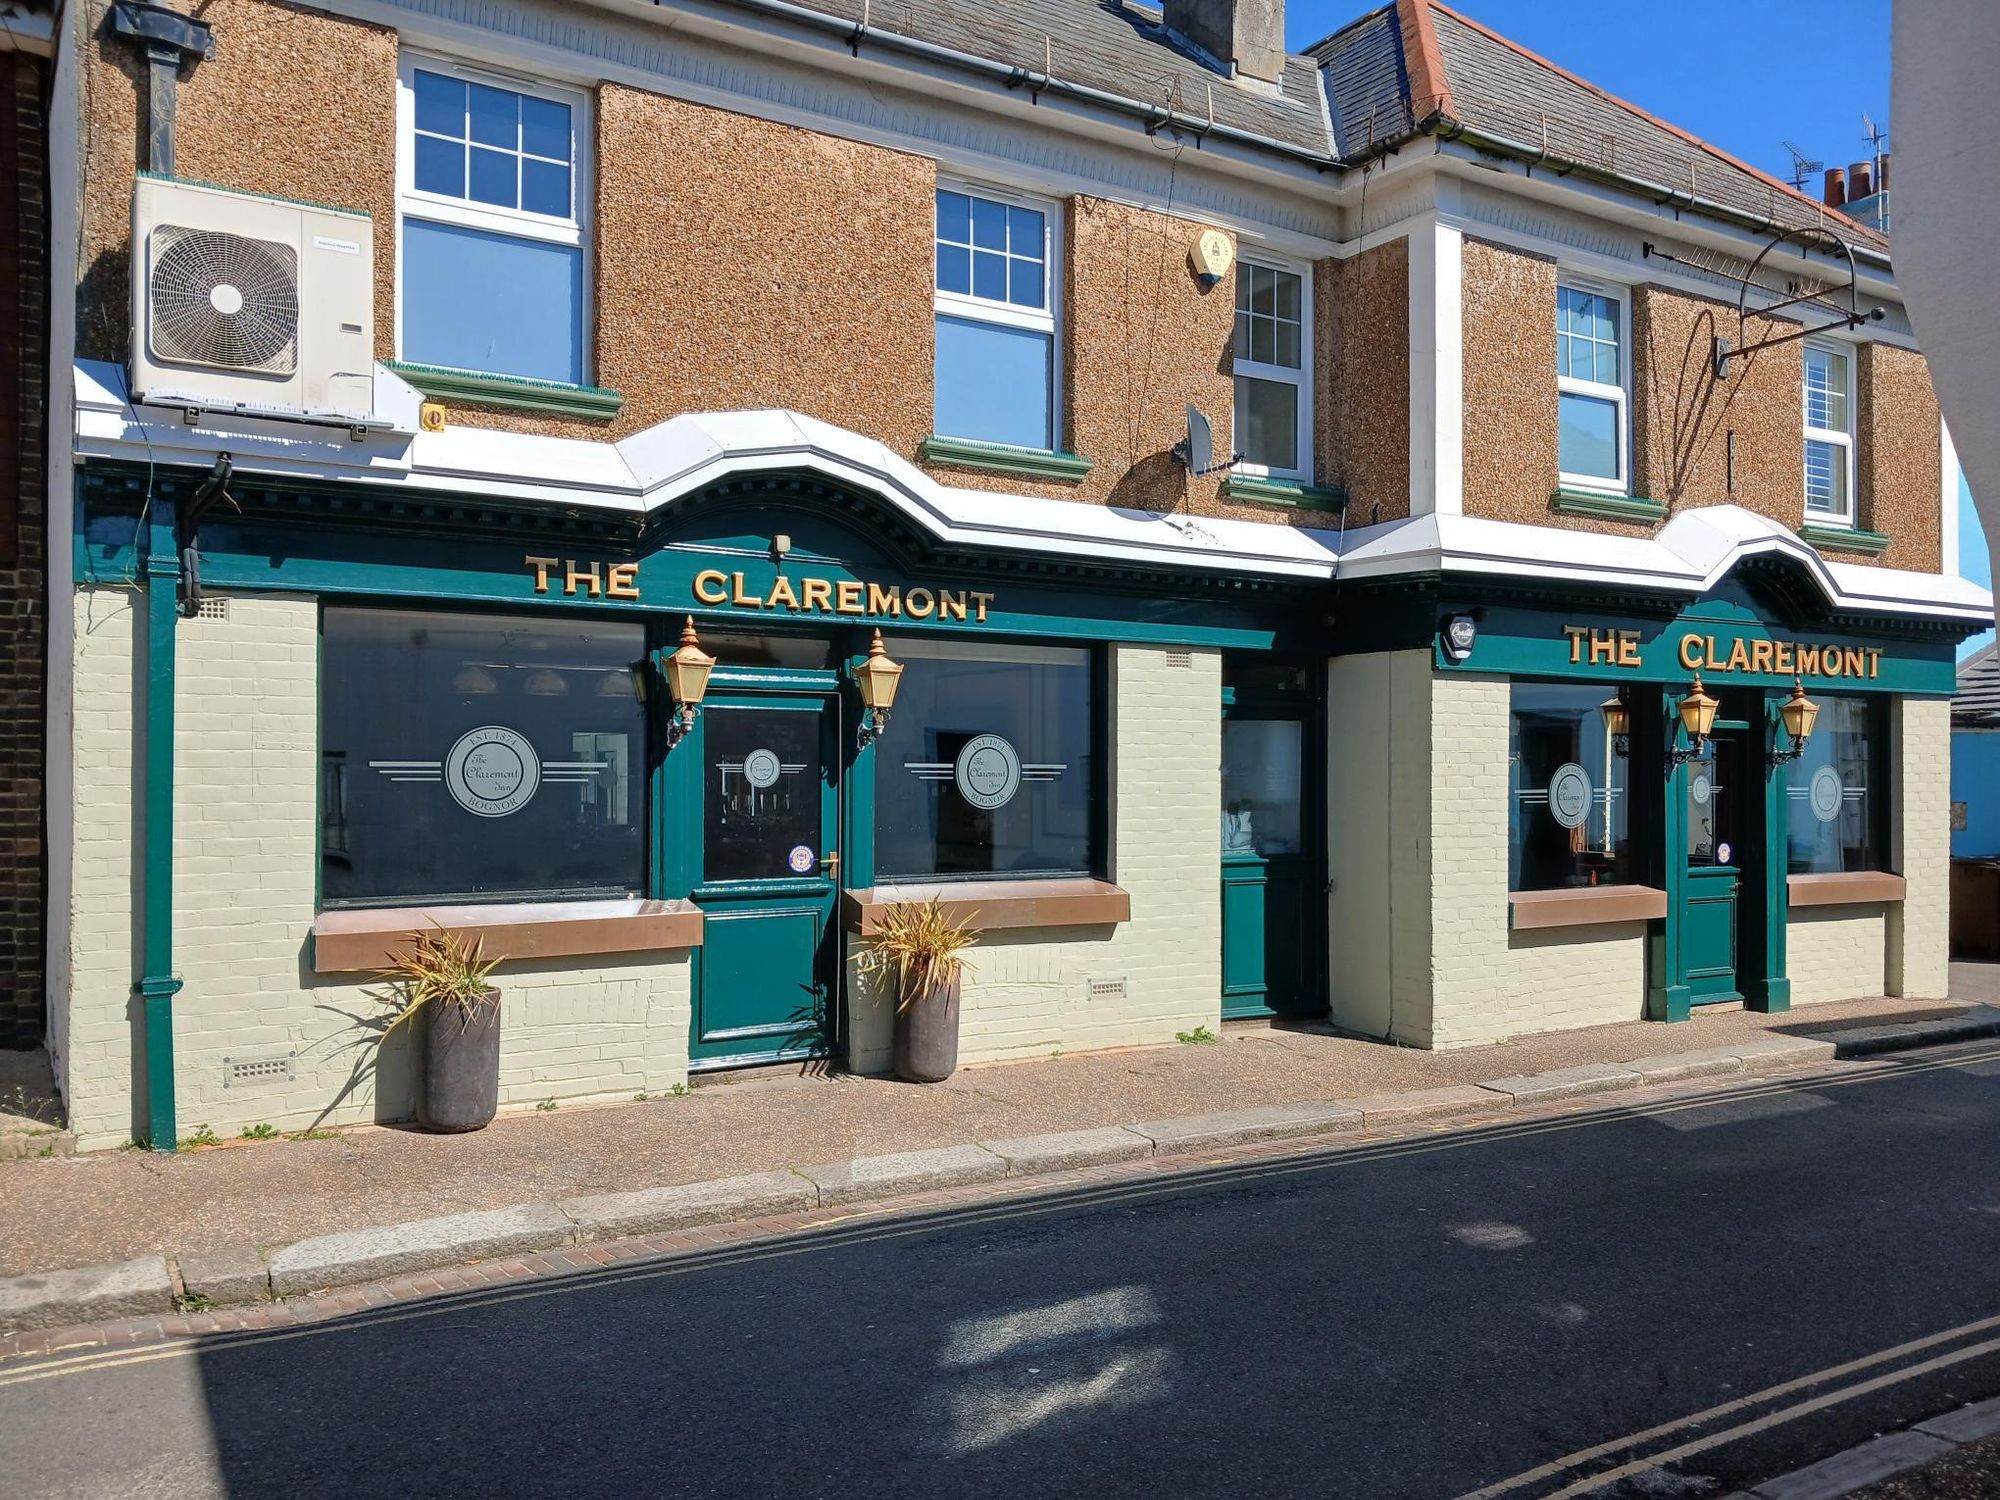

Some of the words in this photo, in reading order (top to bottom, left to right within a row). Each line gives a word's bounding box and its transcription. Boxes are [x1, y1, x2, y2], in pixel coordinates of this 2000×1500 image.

[525, 554, 640, 600] THE
[692, 569, 995, 623] CLAREMONT
[1562, 624, 1642, 668] THE
[1678, 633, 1884, 678] CLAREMONT
[471, 754, 488, 764] The
[466, 766, 519, 779] Claremont
[969, 767, 1006, 778] Claremont
[494, 781, 511, 791] Inn
[467, 797, 518, 811] BOGNOR
[970, 792, 1005, 804] BOGNOR
